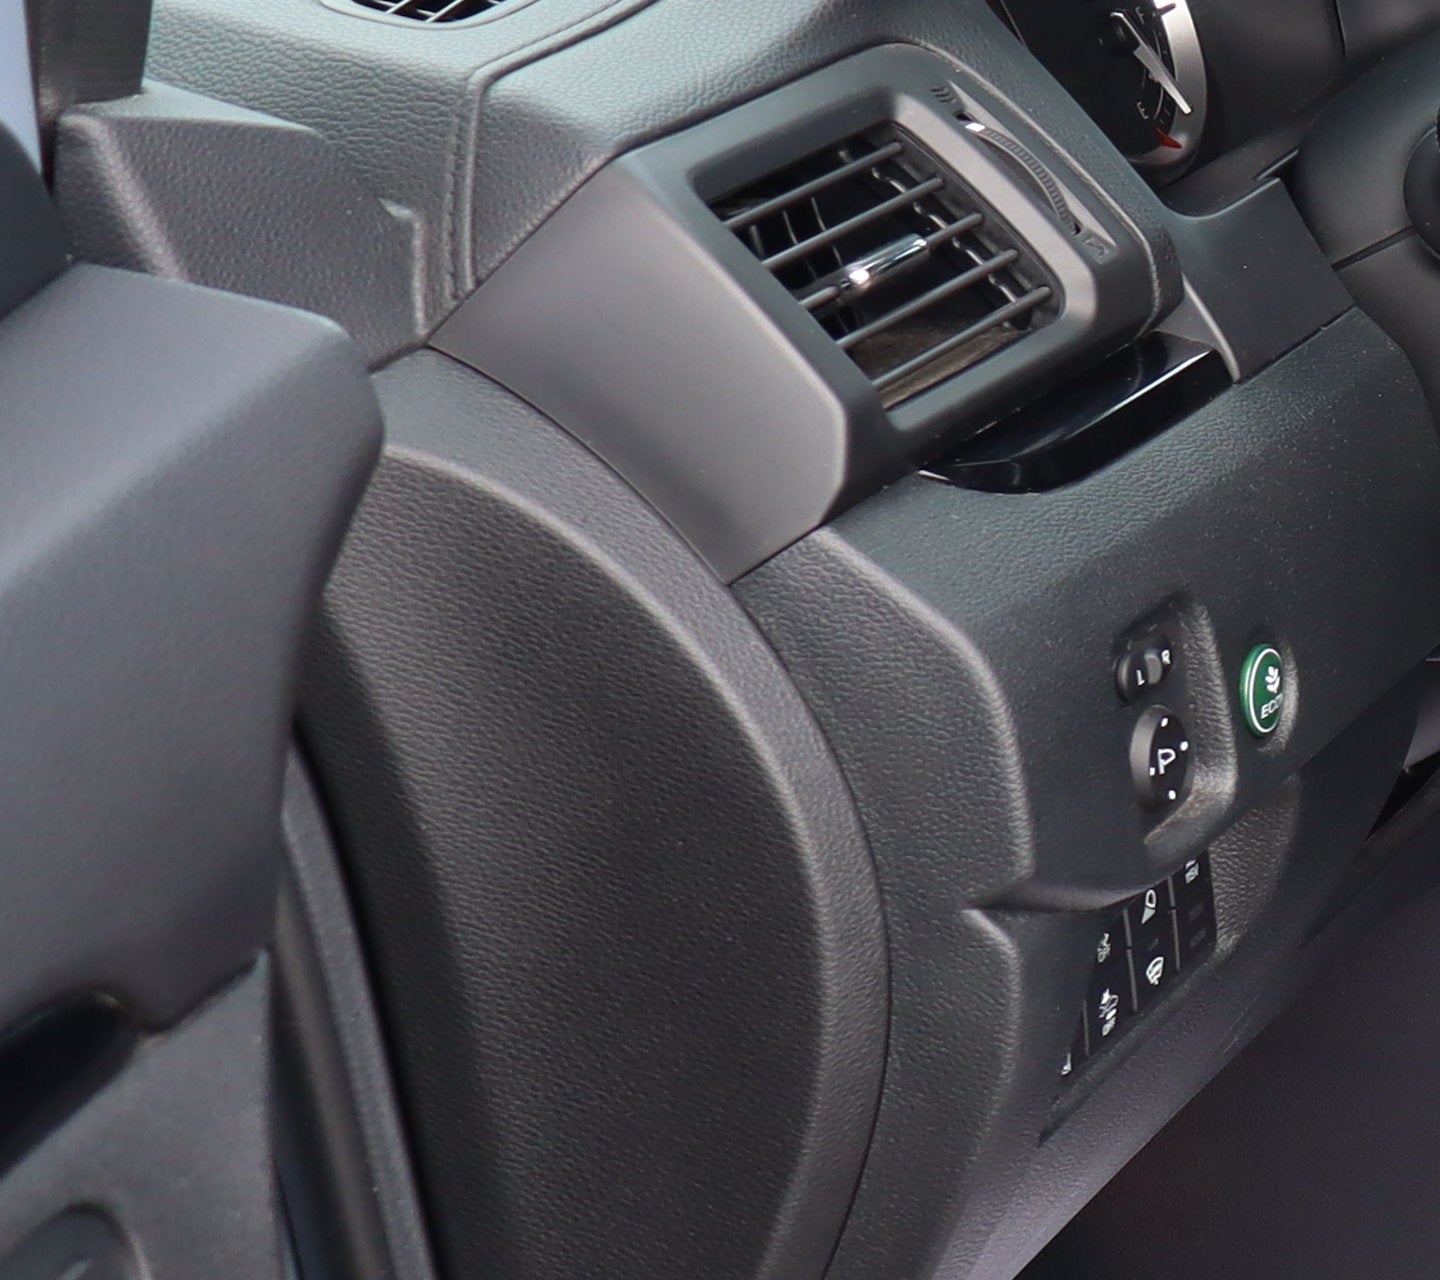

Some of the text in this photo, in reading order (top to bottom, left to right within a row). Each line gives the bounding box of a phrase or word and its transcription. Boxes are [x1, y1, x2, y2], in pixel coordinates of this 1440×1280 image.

[1135, 6, 1145, 25] F
[1136, 101, 1149, 120] E
[1136, 649, 1171, 686] L R
